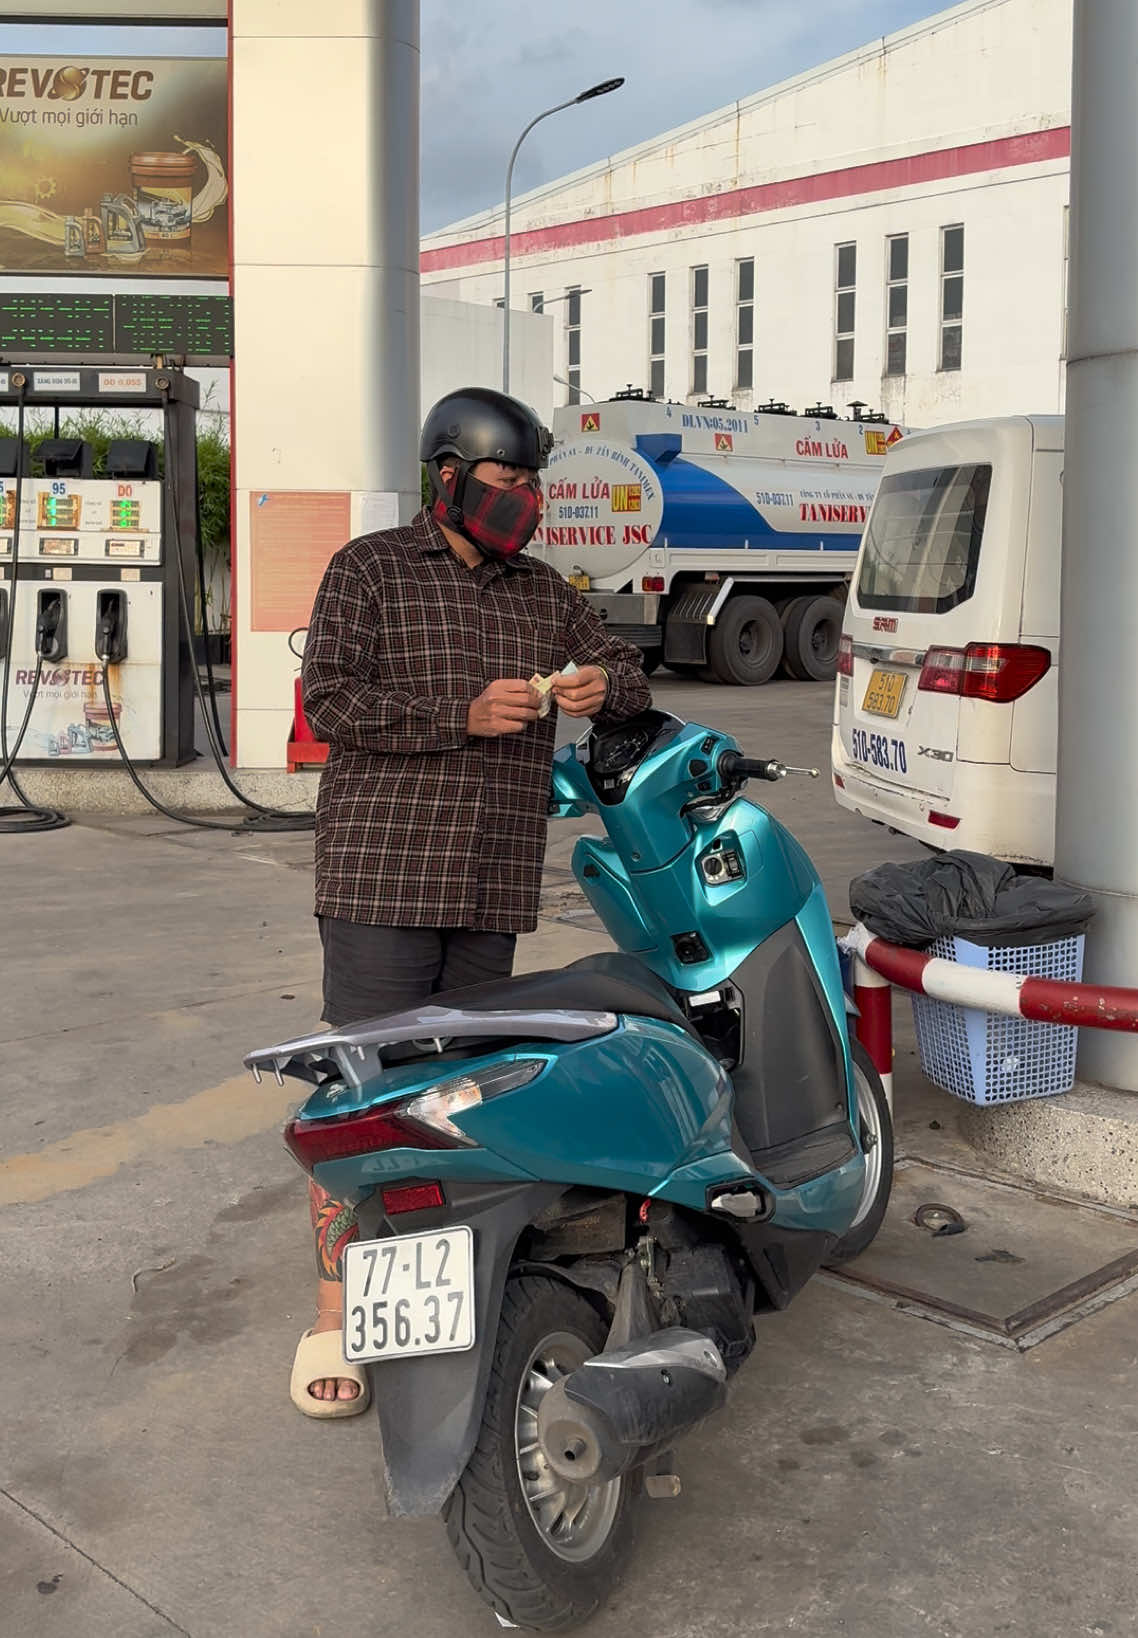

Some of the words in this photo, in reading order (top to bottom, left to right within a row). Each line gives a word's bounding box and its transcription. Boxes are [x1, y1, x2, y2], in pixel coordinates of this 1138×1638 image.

[42, 108, 71, 127] mọi
[76, 108, 103, 128] giới
[109, 109, 138, 128] hạn
[666, 406, 672, 418] 4
[753, 415, 760, 425] 5
[815, 420, 821, 431] 3
[858, 424, 864, 436] 2
[796, 435, 822, 457] CẤM
[825, 437, 849, 460] LỬA
[52, 482, 66, 495] 95
[548, 477, 577, 499] CẤM
[582, 475, 610, 499] LỬA
[622, 524, 652, 545] JSC
[917, 745, 954, 763] X30
[363, 1238, 451, 1297] 77-L2
[351, 1291, 464, 1353] 356.37
